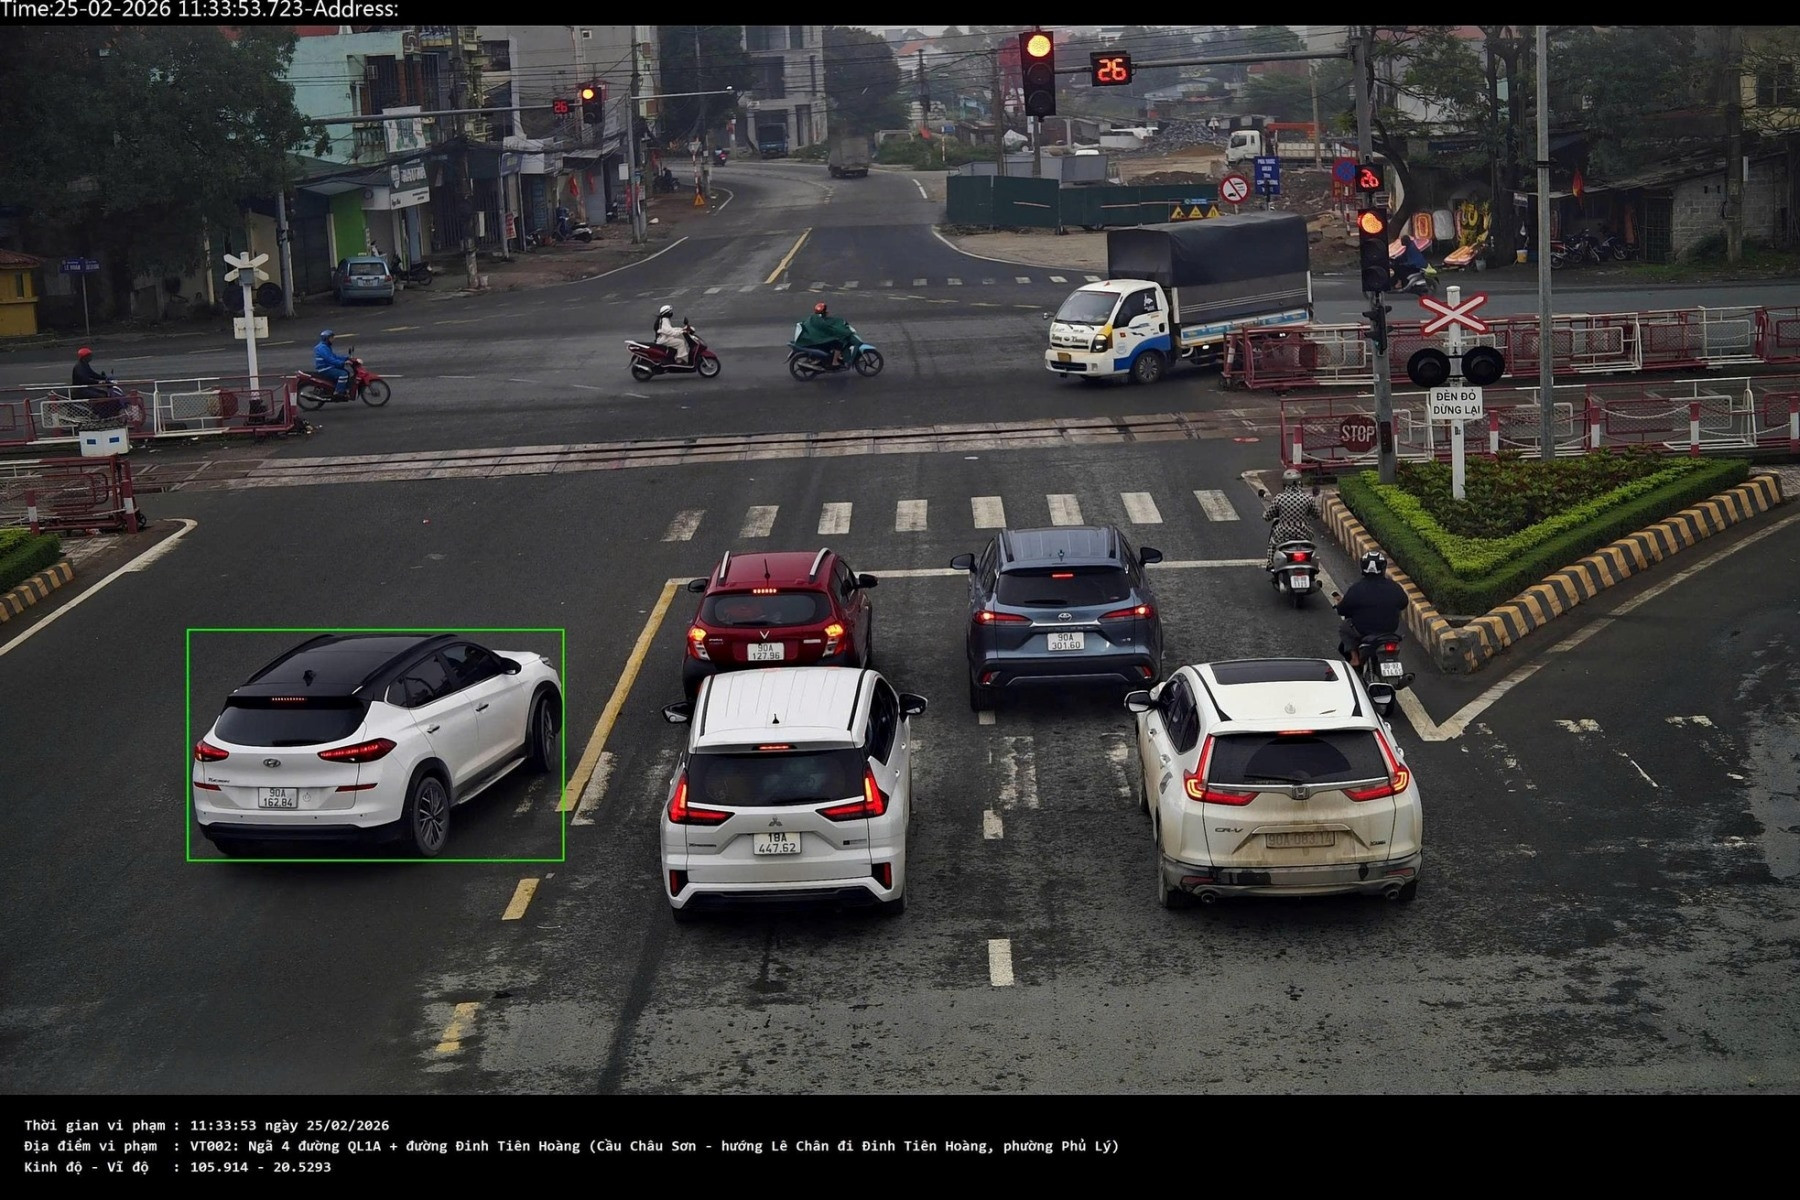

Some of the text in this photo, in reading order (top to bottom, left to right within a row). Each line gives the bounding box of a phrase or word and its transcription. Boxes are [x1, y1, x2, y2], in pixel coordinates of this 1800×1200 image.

[1098, 58, 1126, 80] 26
[553, 101, 568, 113] 26
[1436, 389, 1477, 401] ĐÈN ĐỎ
[1433, 405, 1480, 416] DỪNG LẠI
[1341, 425, 1375, 442] STOP
[1057, 633, 1074, 641] 90A
[757, 644, 774, 652] 90A
[1052, 642, 1081, 650] 301.60
[752, 652, 780, 660] 127.96
[269, 788, 286, 798] 90A
[263, 797, 293, 807] 162.84
[767, 833, 787, 843] 18A
[759, 843, 796, 853] 447.62
